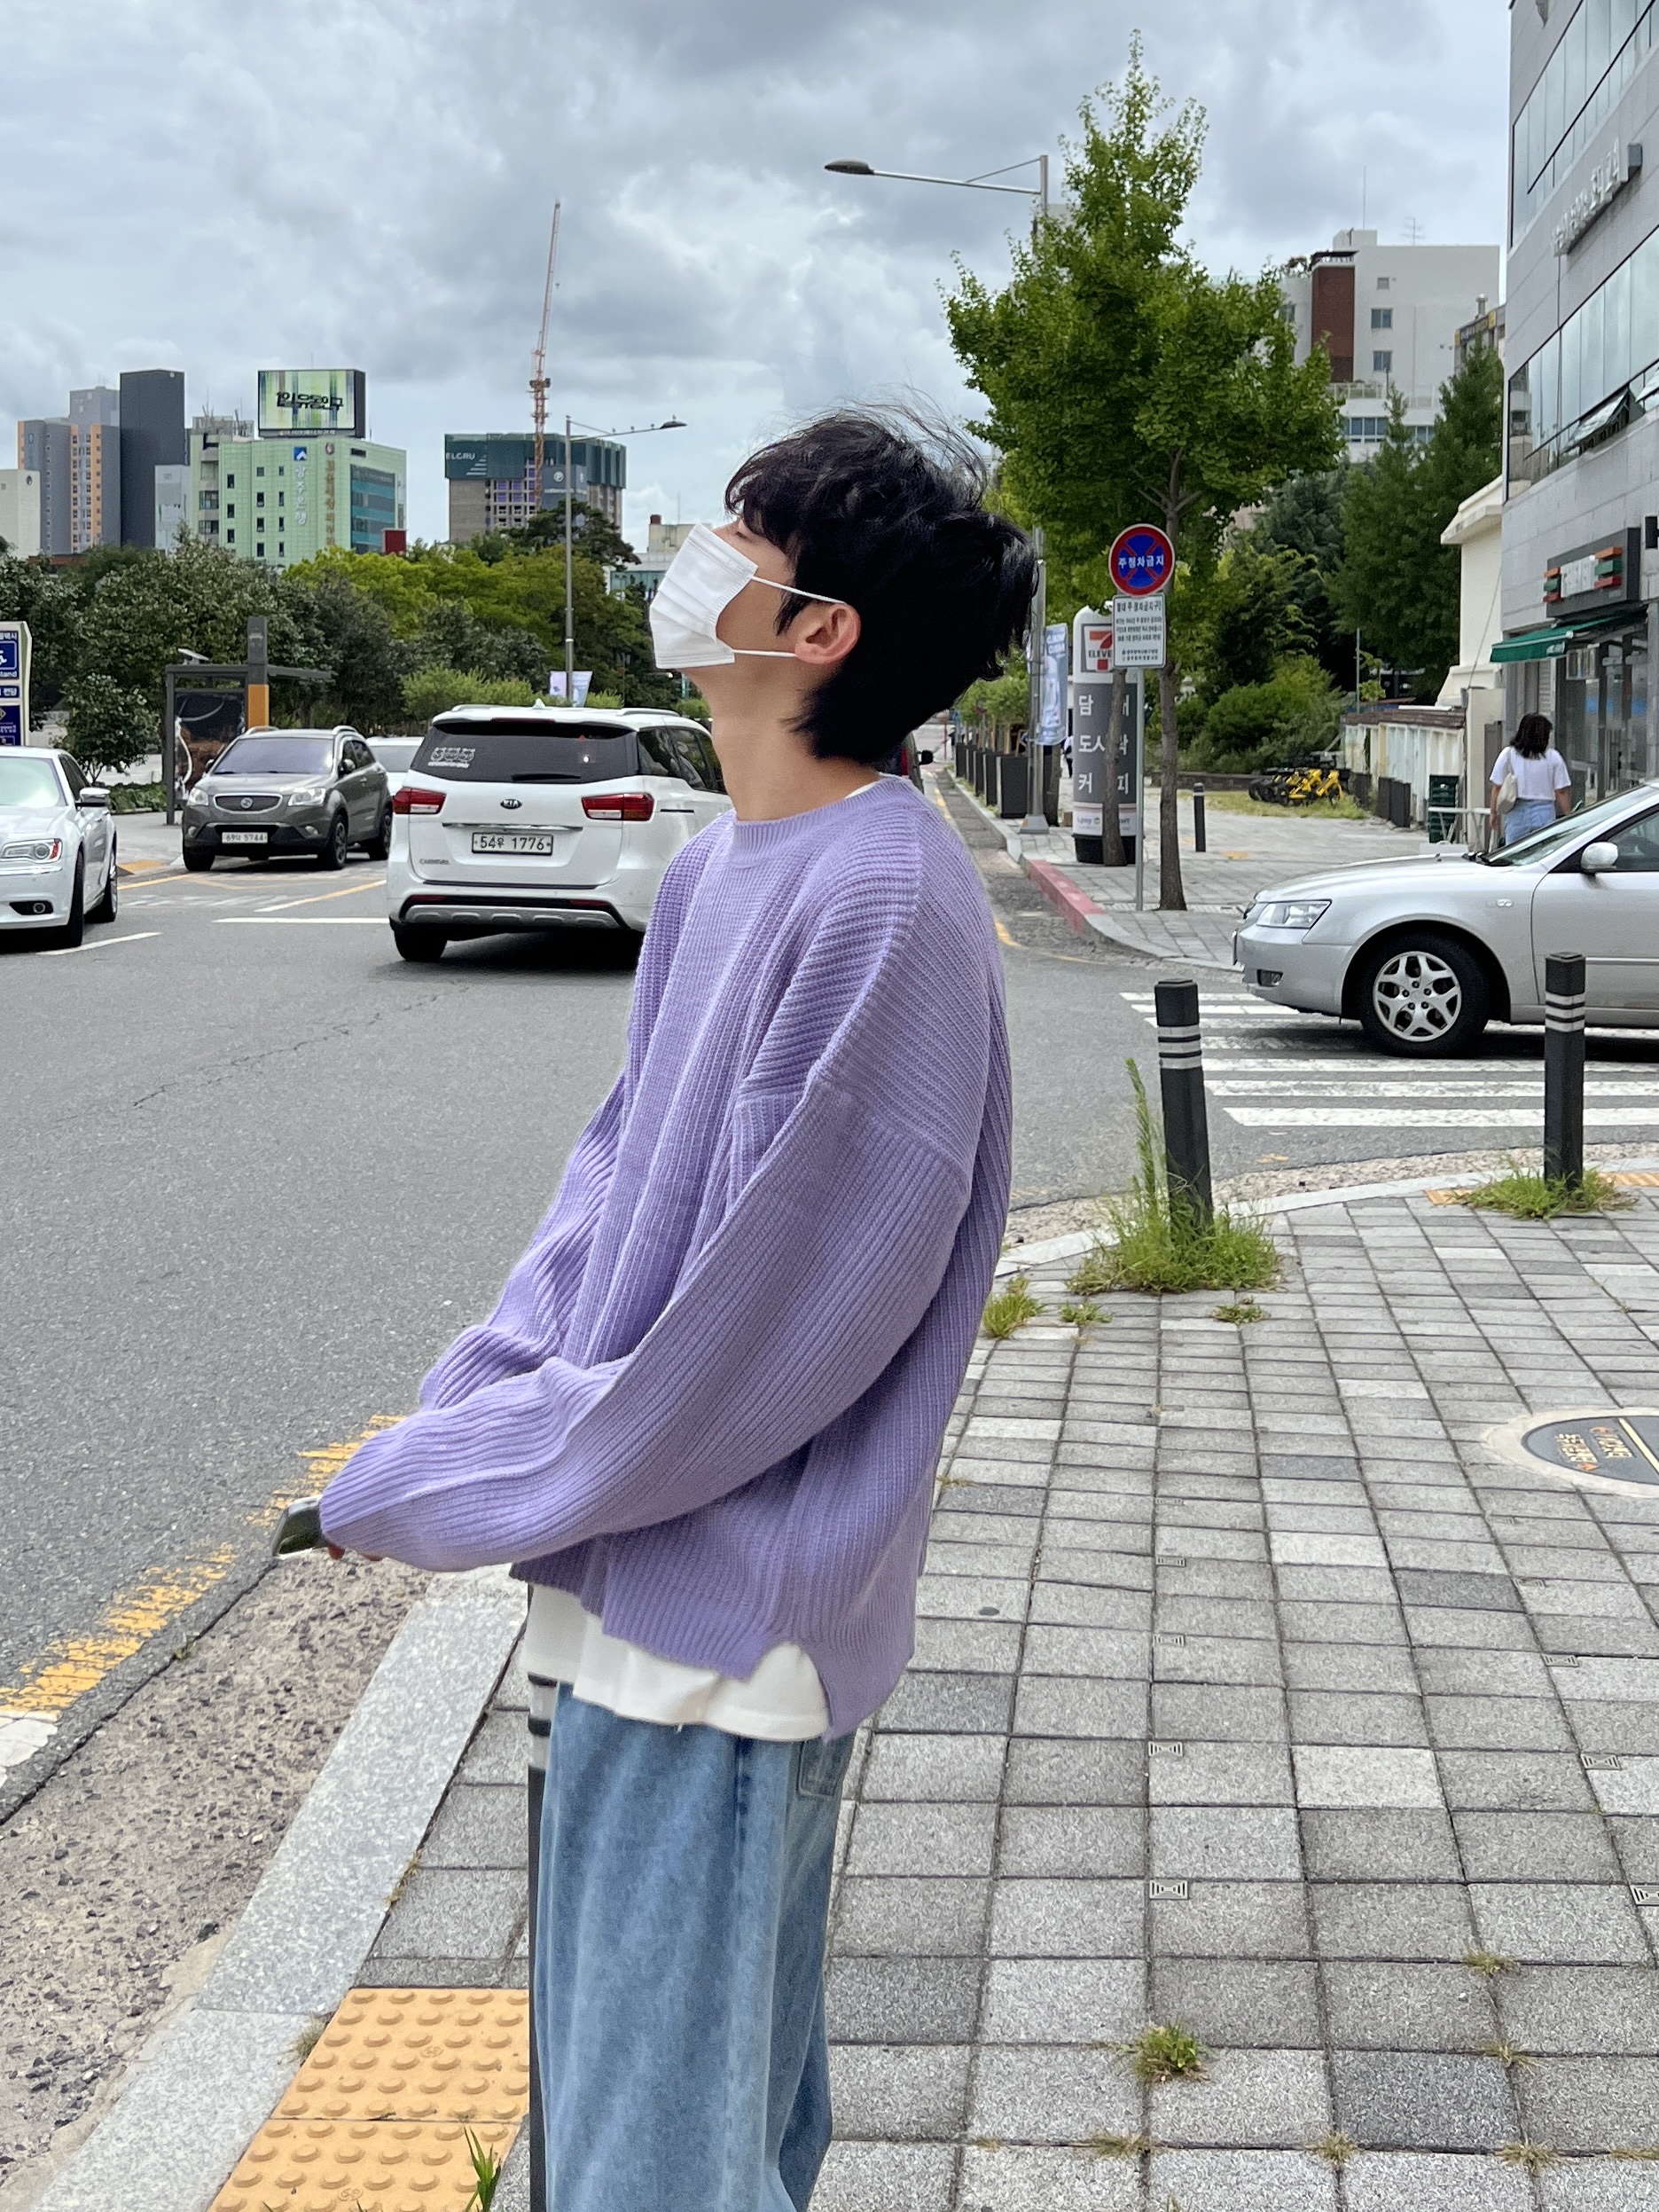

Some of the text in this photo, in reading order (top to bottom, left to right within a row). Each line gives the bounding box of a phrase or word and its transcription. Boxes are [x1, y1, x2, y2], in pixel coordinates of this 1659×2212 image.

[294, 466, 307, 525] 광주은행
[1118, 554, 1164, 569] 주정차금지
[1088, 649, 1113, 658] ELEVE
[512, 836, 544, 851] 1776
